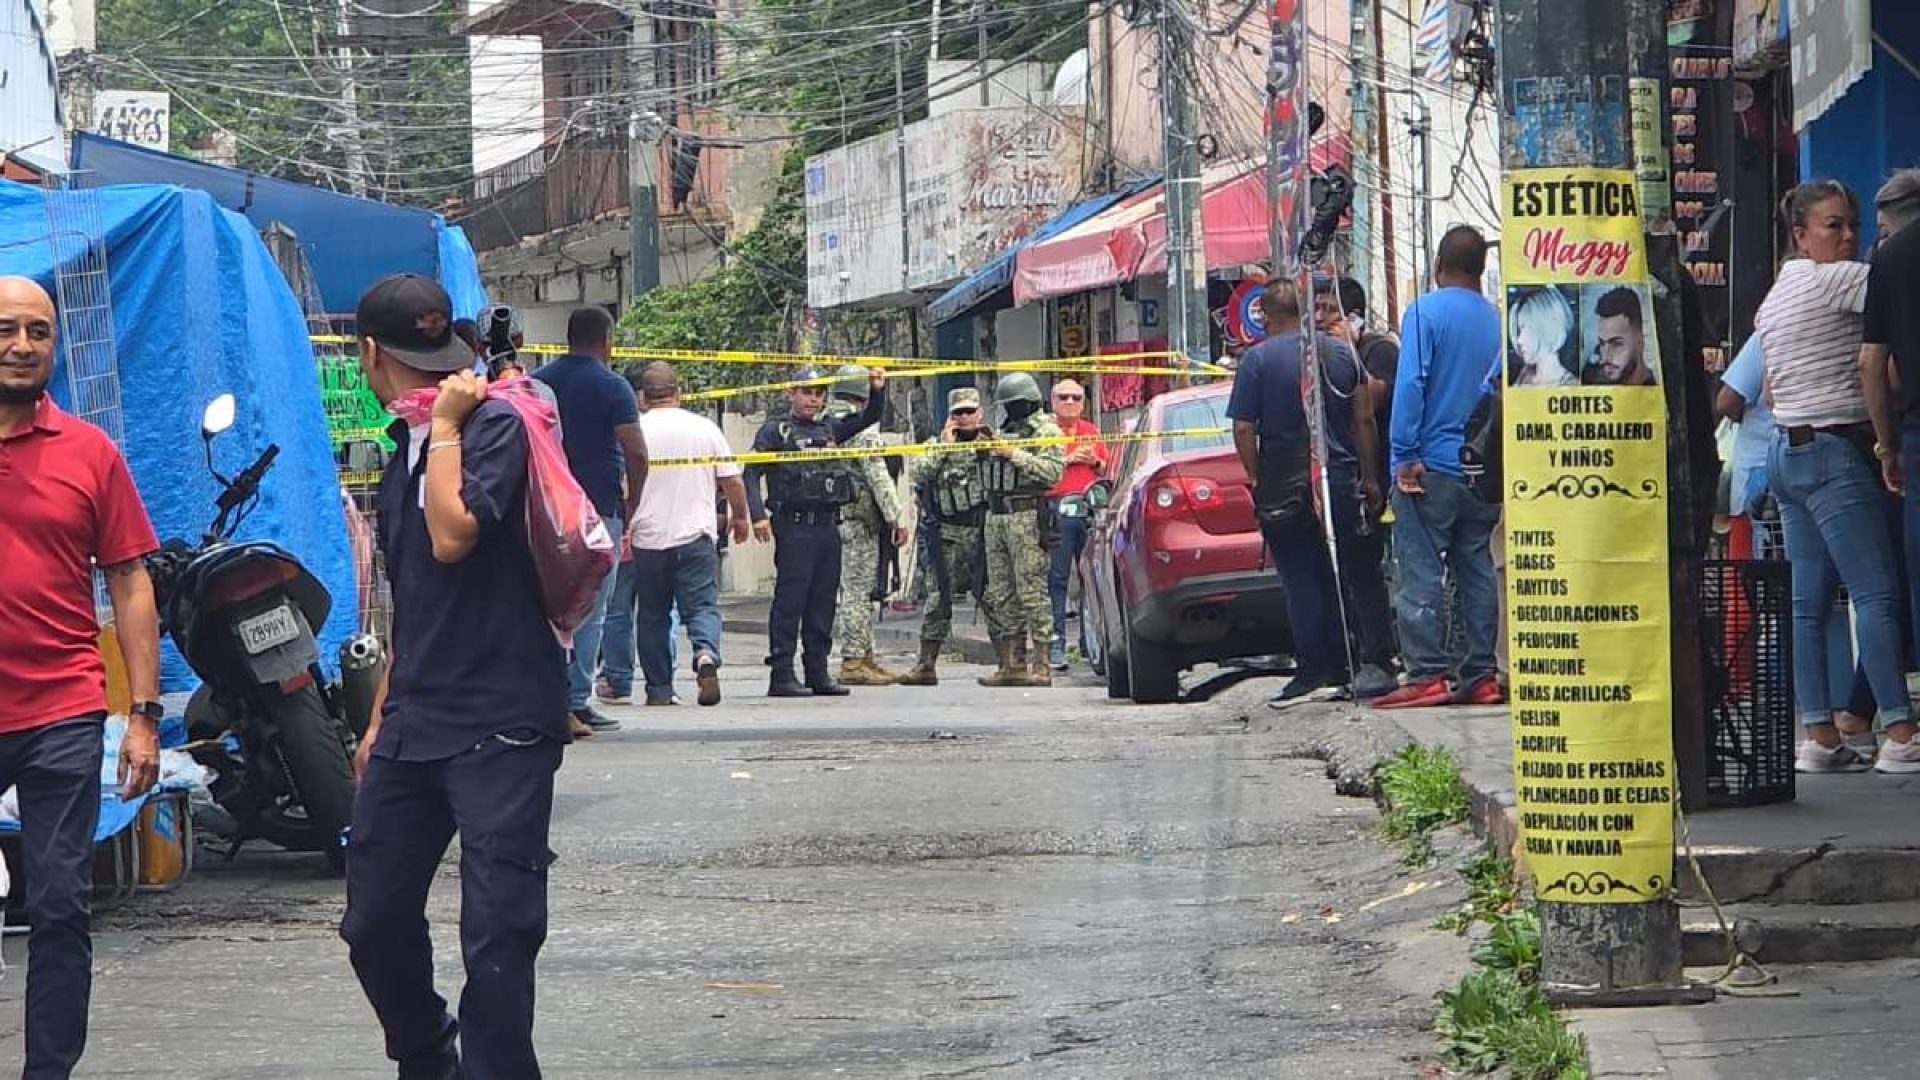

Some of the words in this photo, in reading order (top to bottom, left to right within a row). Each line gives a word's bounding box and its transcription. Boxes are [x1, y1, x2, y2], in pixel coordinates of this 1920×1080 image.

[1511, 174, 1638, 217] ESTÉTICA
[1522, 226, 1633, 277] Maggy
[1547, 395, 1614, 414] CORTES
[1516, 423, 1558, 442] DAMA,
[1562, 422, 1654, 441] CABALLERO
[1549, 449, 1557, 468] Y
[1561, 446, 1614, 468] NIÑOS
[1517, 605, 1639, 622] DECOLORACIONES
[1517, 632, 1580, 649] PEDICURE
[1519, 659, 1586, 676] MANICURE
[1519, 684, 1550, 701] UÑAS
[1553, 685, 1633, 701] ACRILICAS
[1520, 710, 1560, 727] GELISH
[1567, 762, 1585, 779] DE
[1589, 758, 1665, 779] PESTAÑAS
[1523, 787, 1599, 804] PLANCHADO
[1604, 787, 1622, 804] DE
[1626, 787, 1670, 804] CEJAS
[1523, 811, 1599, 831] DEPILACIÓN
[1602, 814, 1634, 831] CON
[1556, 838, 1563, 855] Y
[1566, 839, 1623, 856] NAVAJA
